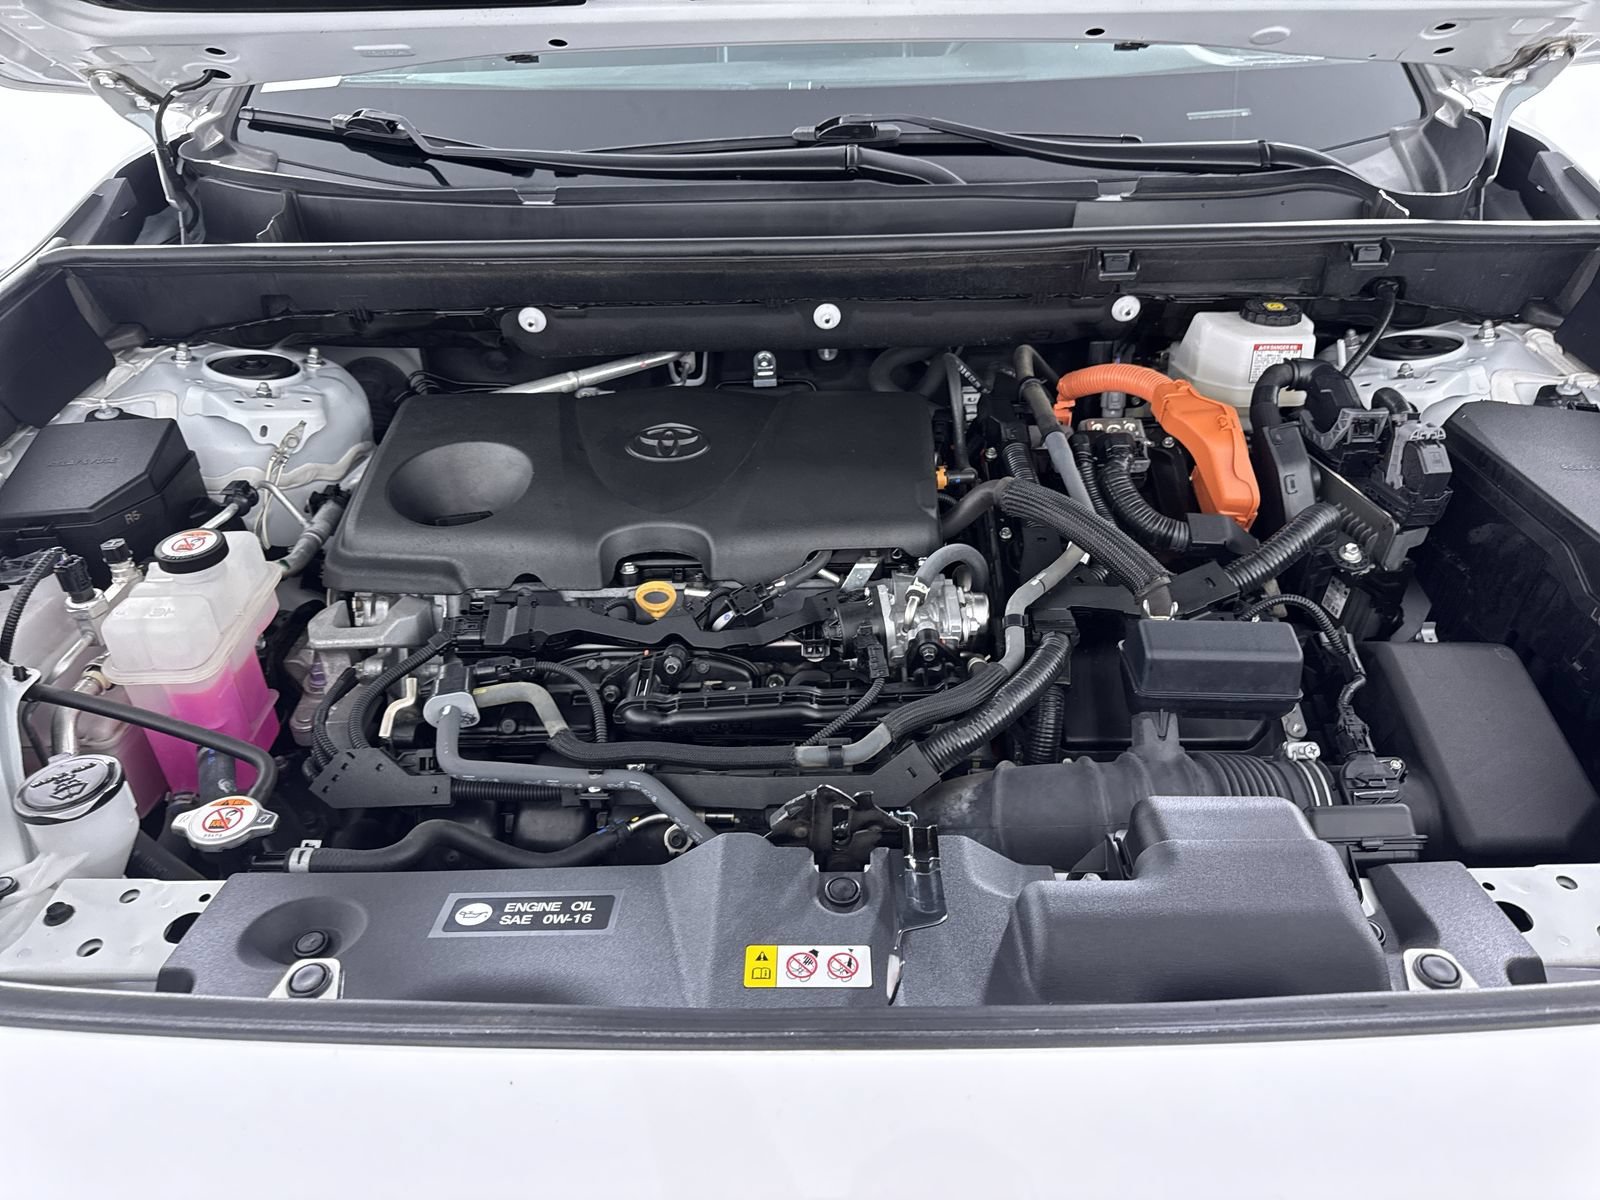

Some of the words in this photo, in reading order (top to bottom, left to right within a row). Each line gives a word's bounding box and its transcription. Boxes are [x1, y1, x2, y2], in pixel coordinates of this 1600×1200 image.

[503, 902, 562, 912] ENGINE
[570, 901, 596, 912] OIL
[499, 914, 533, 925] SAE
[542, 913, 592, 924] 0W-16
